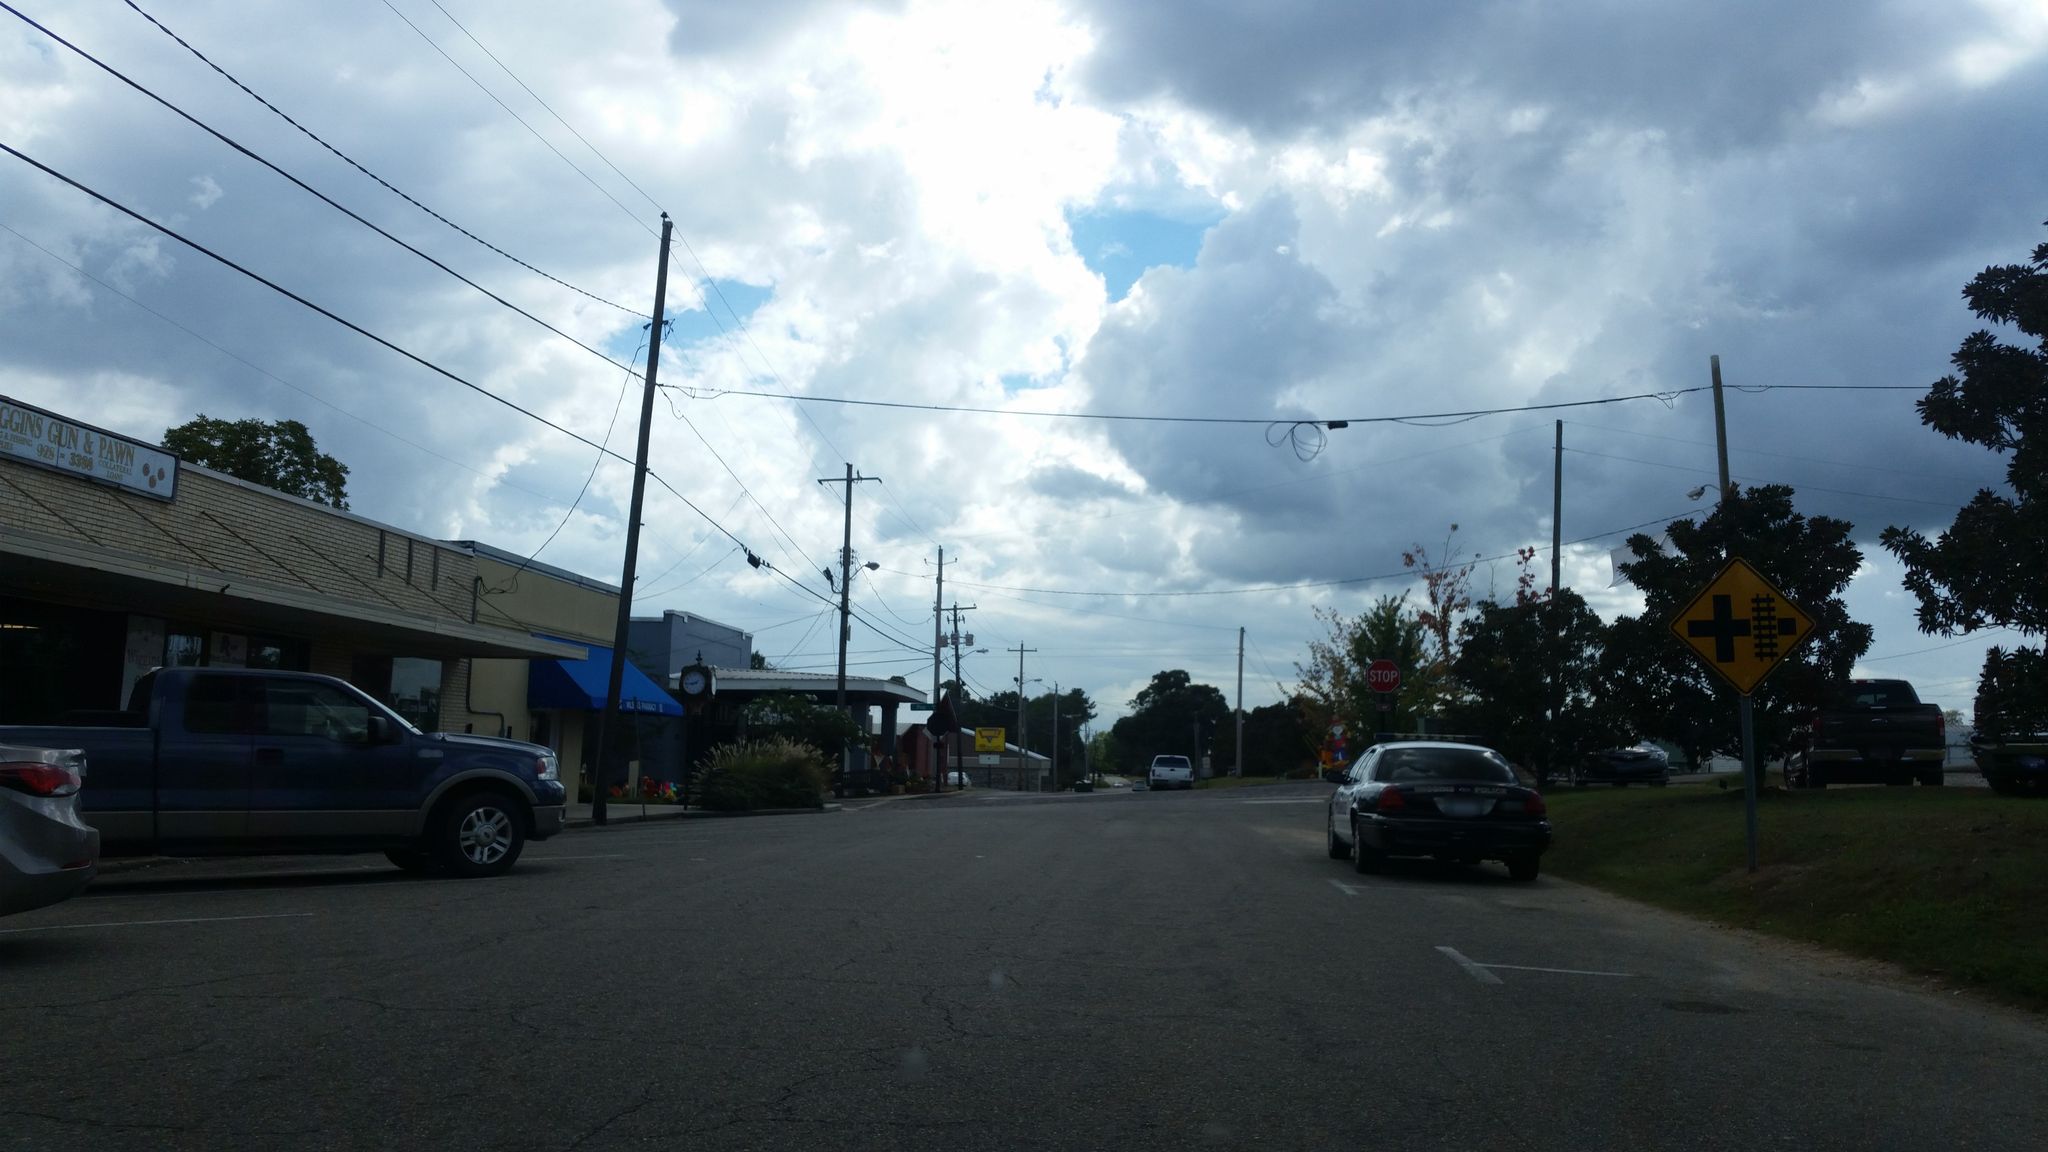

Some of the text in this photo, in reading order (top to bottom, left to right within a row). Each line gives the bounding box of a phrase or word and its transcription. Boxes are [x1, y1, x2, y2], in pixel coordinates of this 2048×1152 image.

[47, 421, 79, 451] GUN
[84, 432, 94, 455] &
[98, 435, 135, 467] PAWN
[1370, 670, 1398, 683] STOP
[1474, 785, 1507, 795] POLICE
